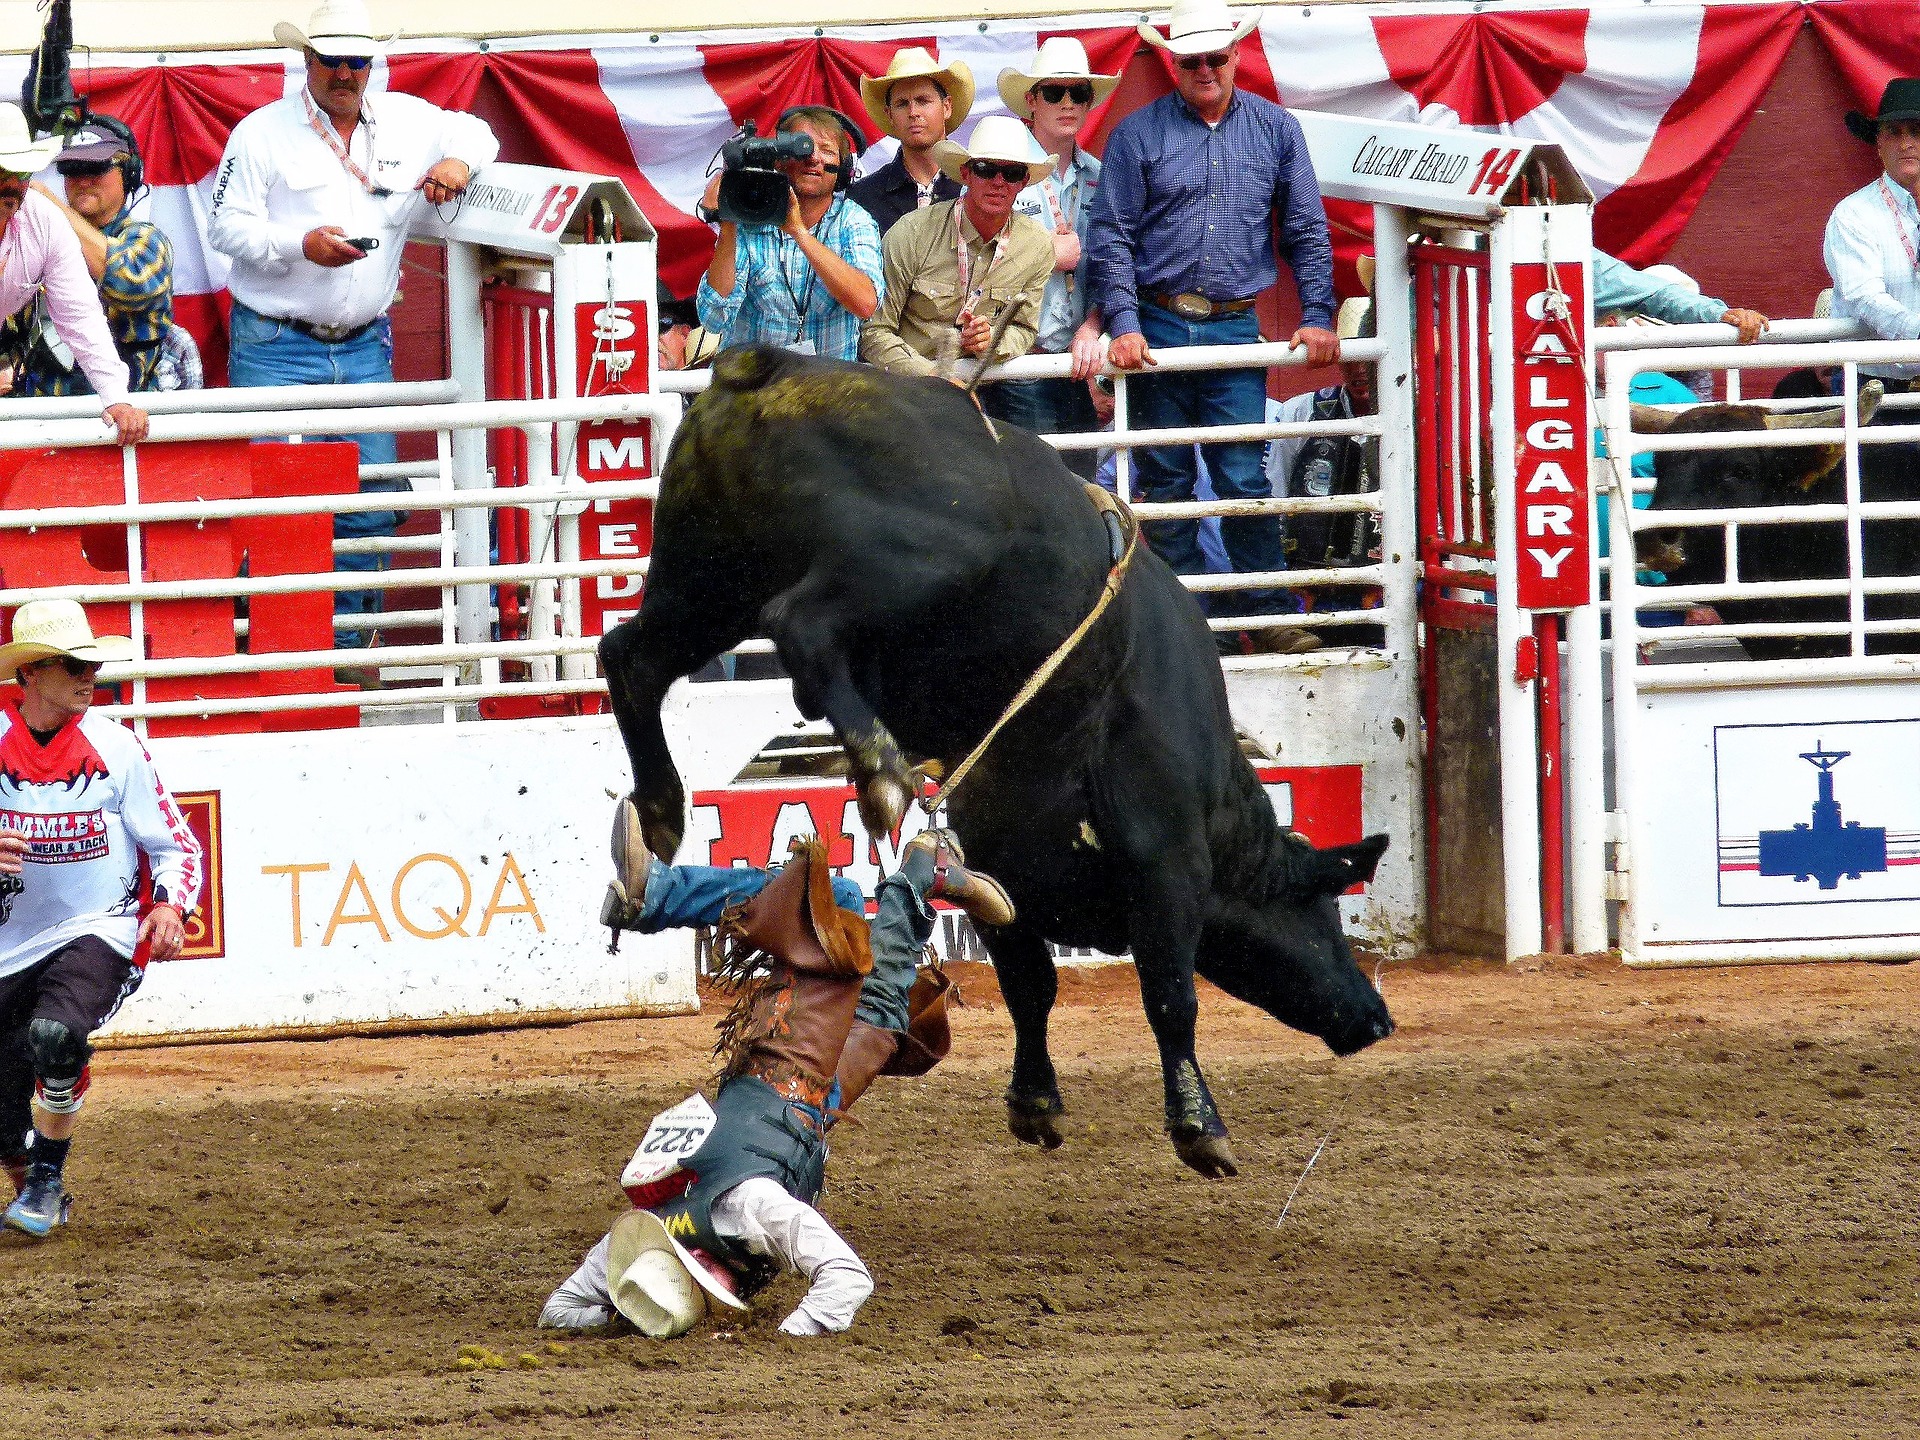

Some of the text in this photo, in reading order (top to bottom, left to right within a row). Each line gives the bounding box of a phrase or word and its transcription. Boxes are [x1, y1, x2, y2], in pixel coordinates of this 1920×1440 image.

[1352, 135, 1523, 196] CALGARY HERALD 14
[529, 184, 579, 233] 13
[1525, 290, 1575, 579] CALGARY
[31, 842, 64, 854] WEAR
[80, 834, 106, 850] TACK
[261, 850, 547, 948] TAQA
[644, 1126, 705, 1153] 322
